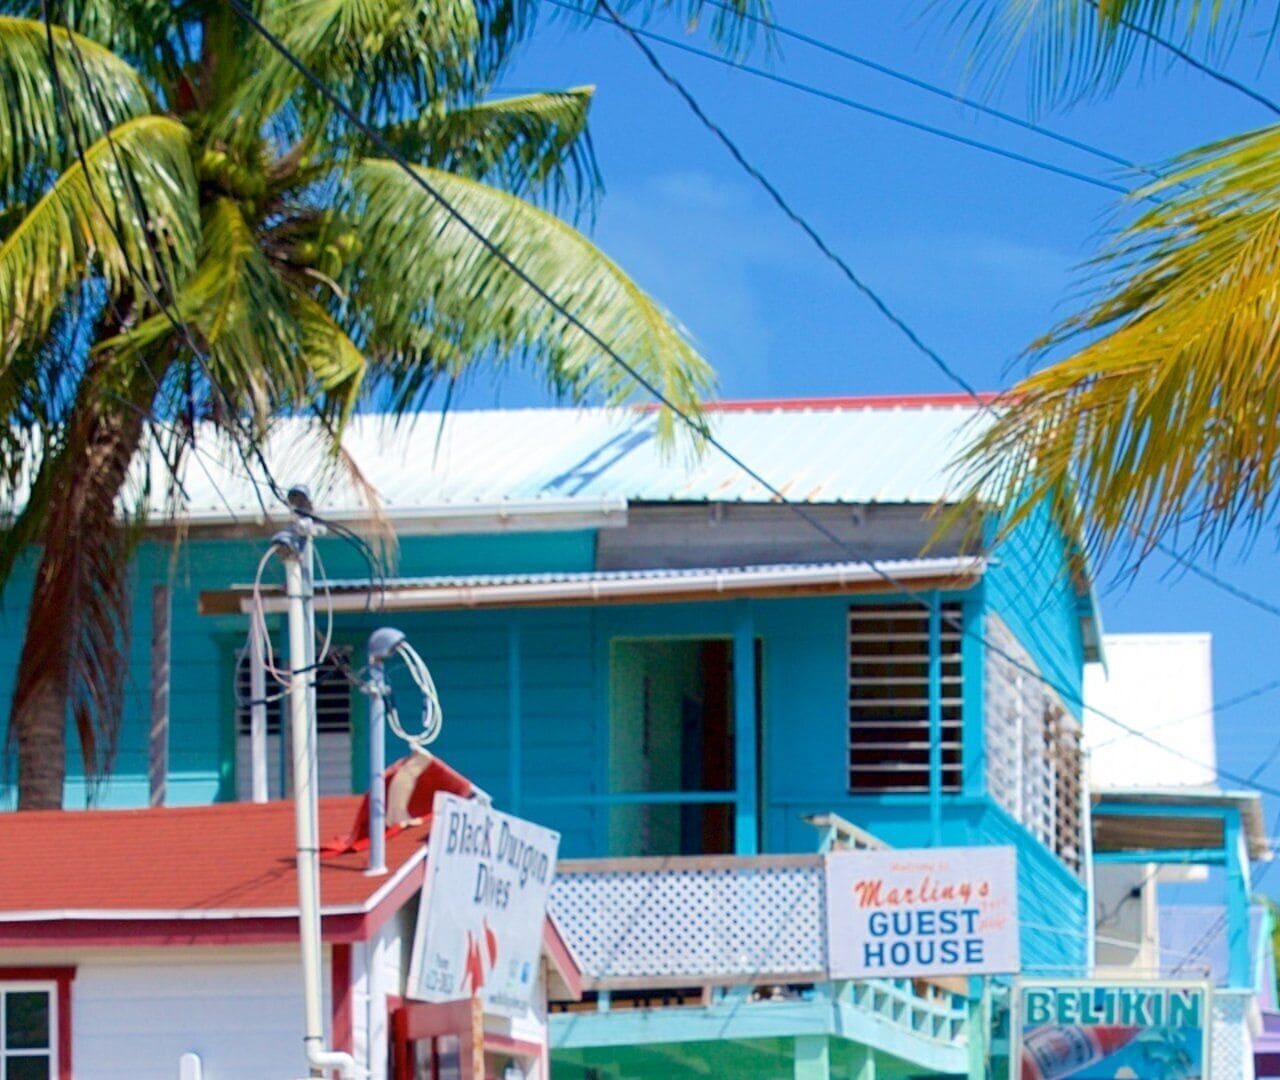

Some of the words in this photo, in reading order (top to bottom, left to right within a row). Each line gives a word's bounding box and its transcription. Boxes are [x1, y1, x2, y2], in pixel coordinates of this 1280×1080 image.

[447, 811, 494, 859] Black
[474, 863, 512, 909] Dives
[869, 909, 980, 937] GUEST
[863, 939, 984, 967] HOUSE
[1027, 991, 1200, 1027] BELIKIN
